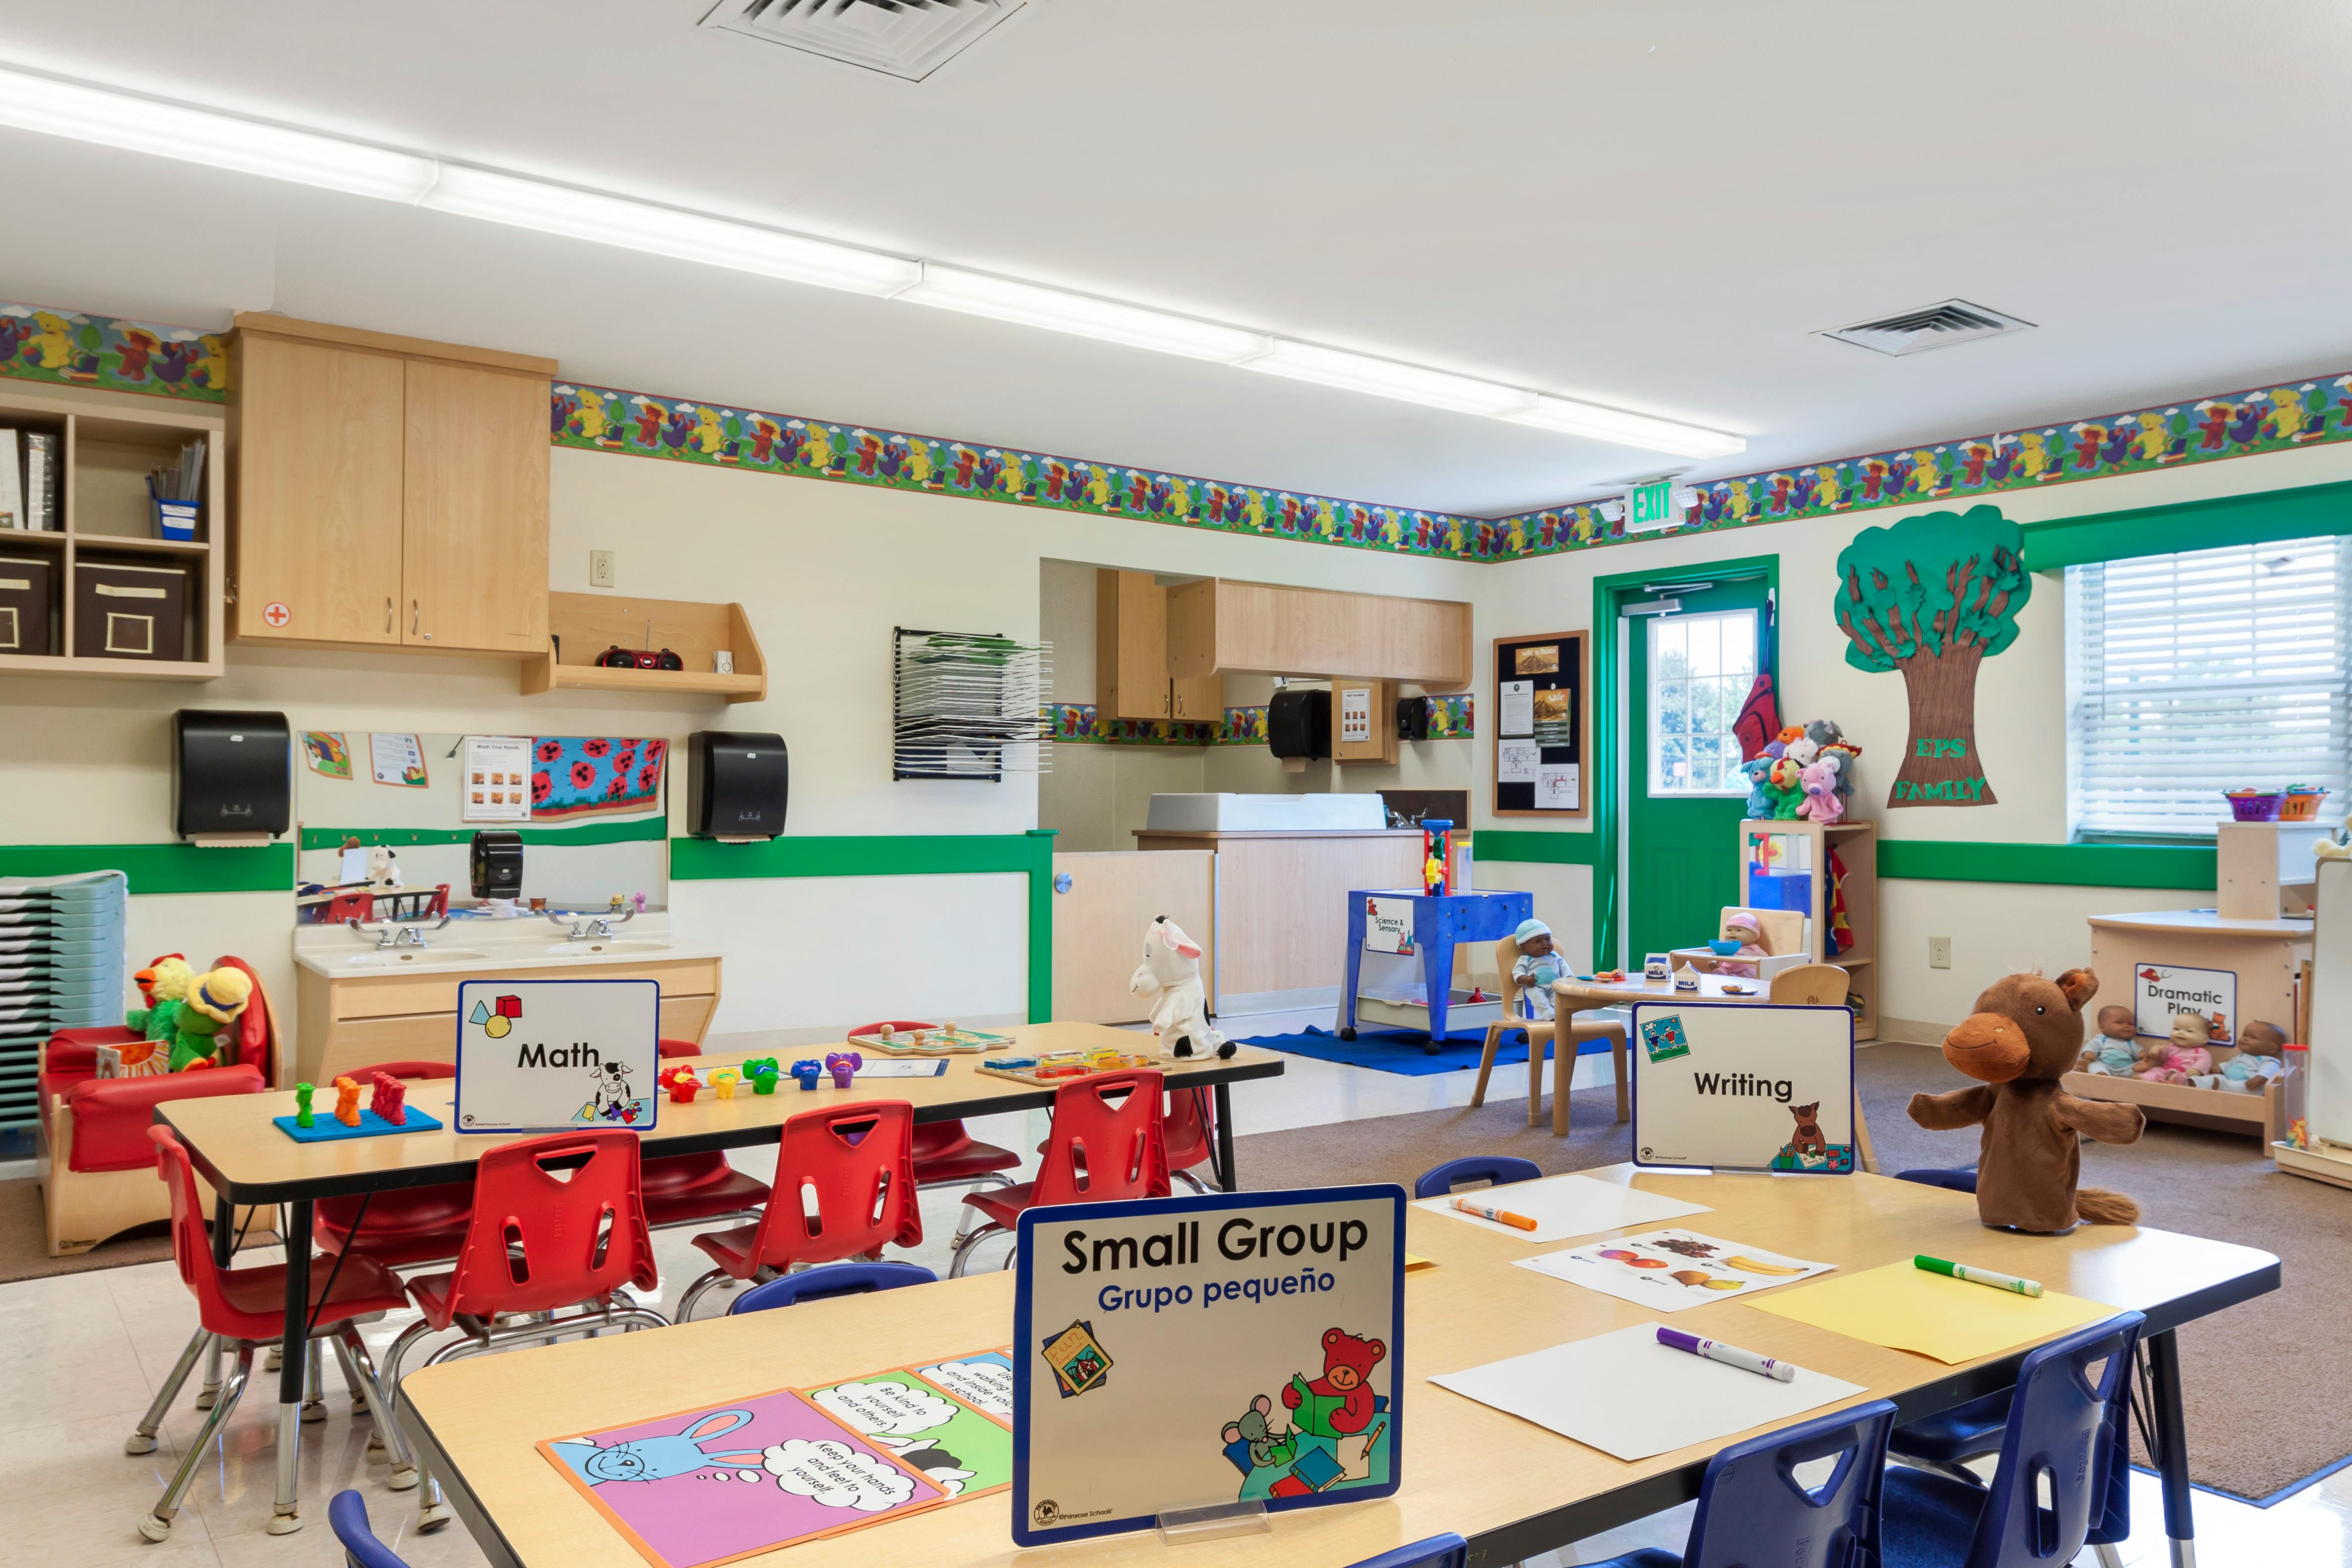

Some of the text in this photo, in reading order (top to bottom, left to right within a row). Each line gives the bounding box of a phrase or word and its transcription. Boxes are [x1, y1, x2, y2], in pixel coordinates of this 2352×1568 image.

[1633, 482, 1671, 523] EXIT
[1548, 691, 1566, 701] safe
[1916, 738, 1967, 758] EPS
[1895, 776, 1986, 802] FAMILY
[1375, 917, 1398, 925] Science
[1378, 924, 1401, 934] Sensory
[2148, 985, 2223, 1004] Dramatic
[517, 1042, 600, 1068] Math
[1694, 1072, 1793, 1103] Writing
[1061, 1218, 1369, 1274] Small Group
[1098, 1267, 1336, 1313] Grupo pequeño
[1049, 1331, 1084, 1362] fun
[946, 1372, 1013, 1409] and inside voic
[973, 1372, 1010, 1391] walking
[861, 1395, 907, 1418] yourself
[880, 1387, 895, 1396] Be
[892, 1395, 920, 1409] kind
[951, 1387, 988, 1406] school.
[837, 1395, 887, 1428] and others.
[787, 1467, 834, 1494] yourself.
[807, 1458, 859, 1491] and feet to
[816, 1443, 895, 1495] Keep your hands
